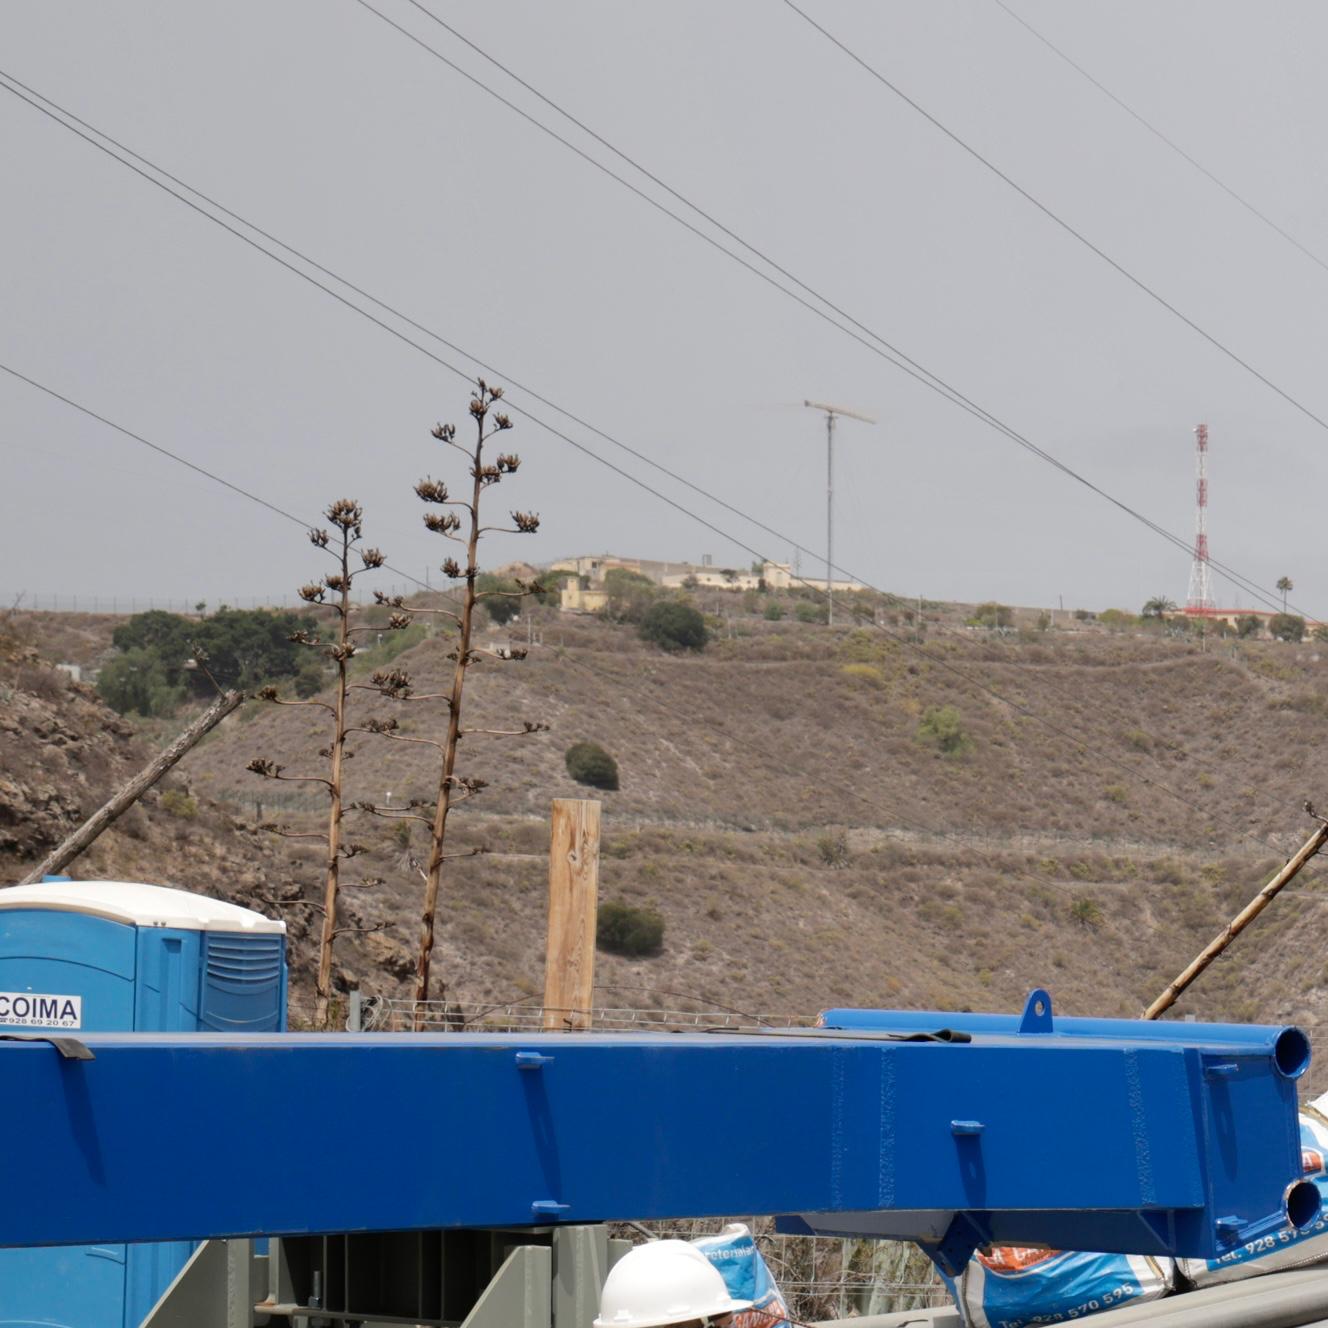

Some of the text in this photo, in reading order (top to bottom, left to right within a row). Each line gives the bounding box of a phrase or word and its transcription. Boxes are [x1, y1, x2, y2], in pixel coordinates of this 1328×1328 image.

[0, 996, 77, 1020] COIMA
[1245, 1236, 1275, 1254] 928
[1068, 1299, 1099, 1318] 570
[1102, 1282, 1133, 1304] 595
